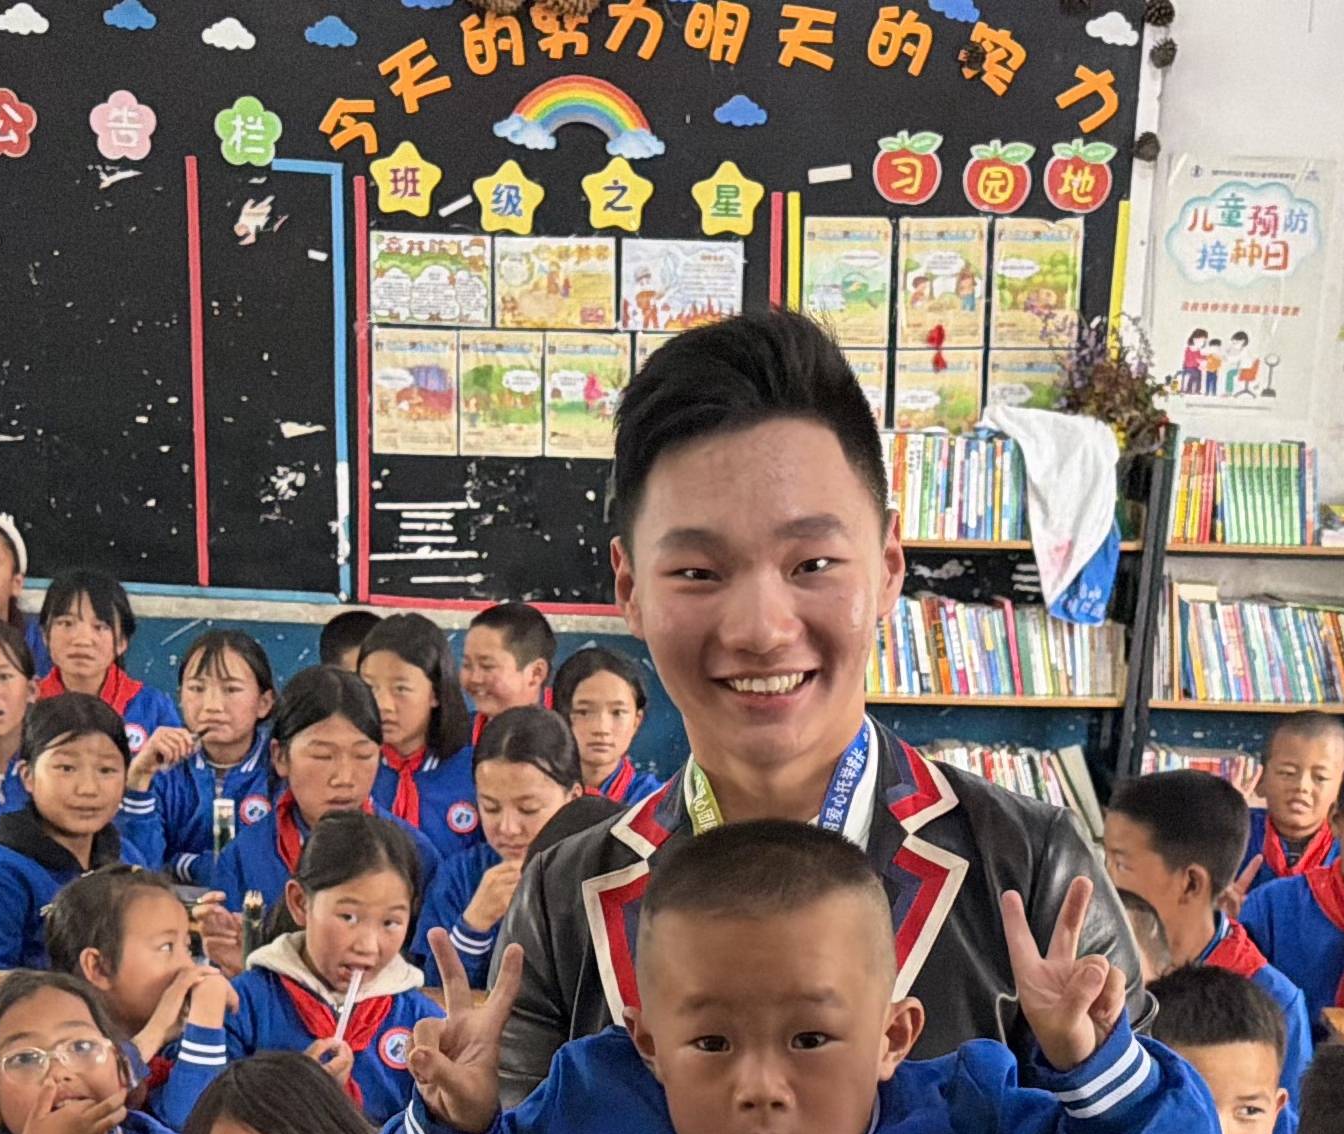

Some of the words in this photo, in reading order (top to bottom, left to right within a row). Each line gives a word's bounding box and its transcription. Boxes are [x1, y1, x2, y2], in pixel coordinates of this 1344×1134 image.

[1188, 193, 1308, 238] 儿童预防
[1197, 240, 1289, 272] 接种日
